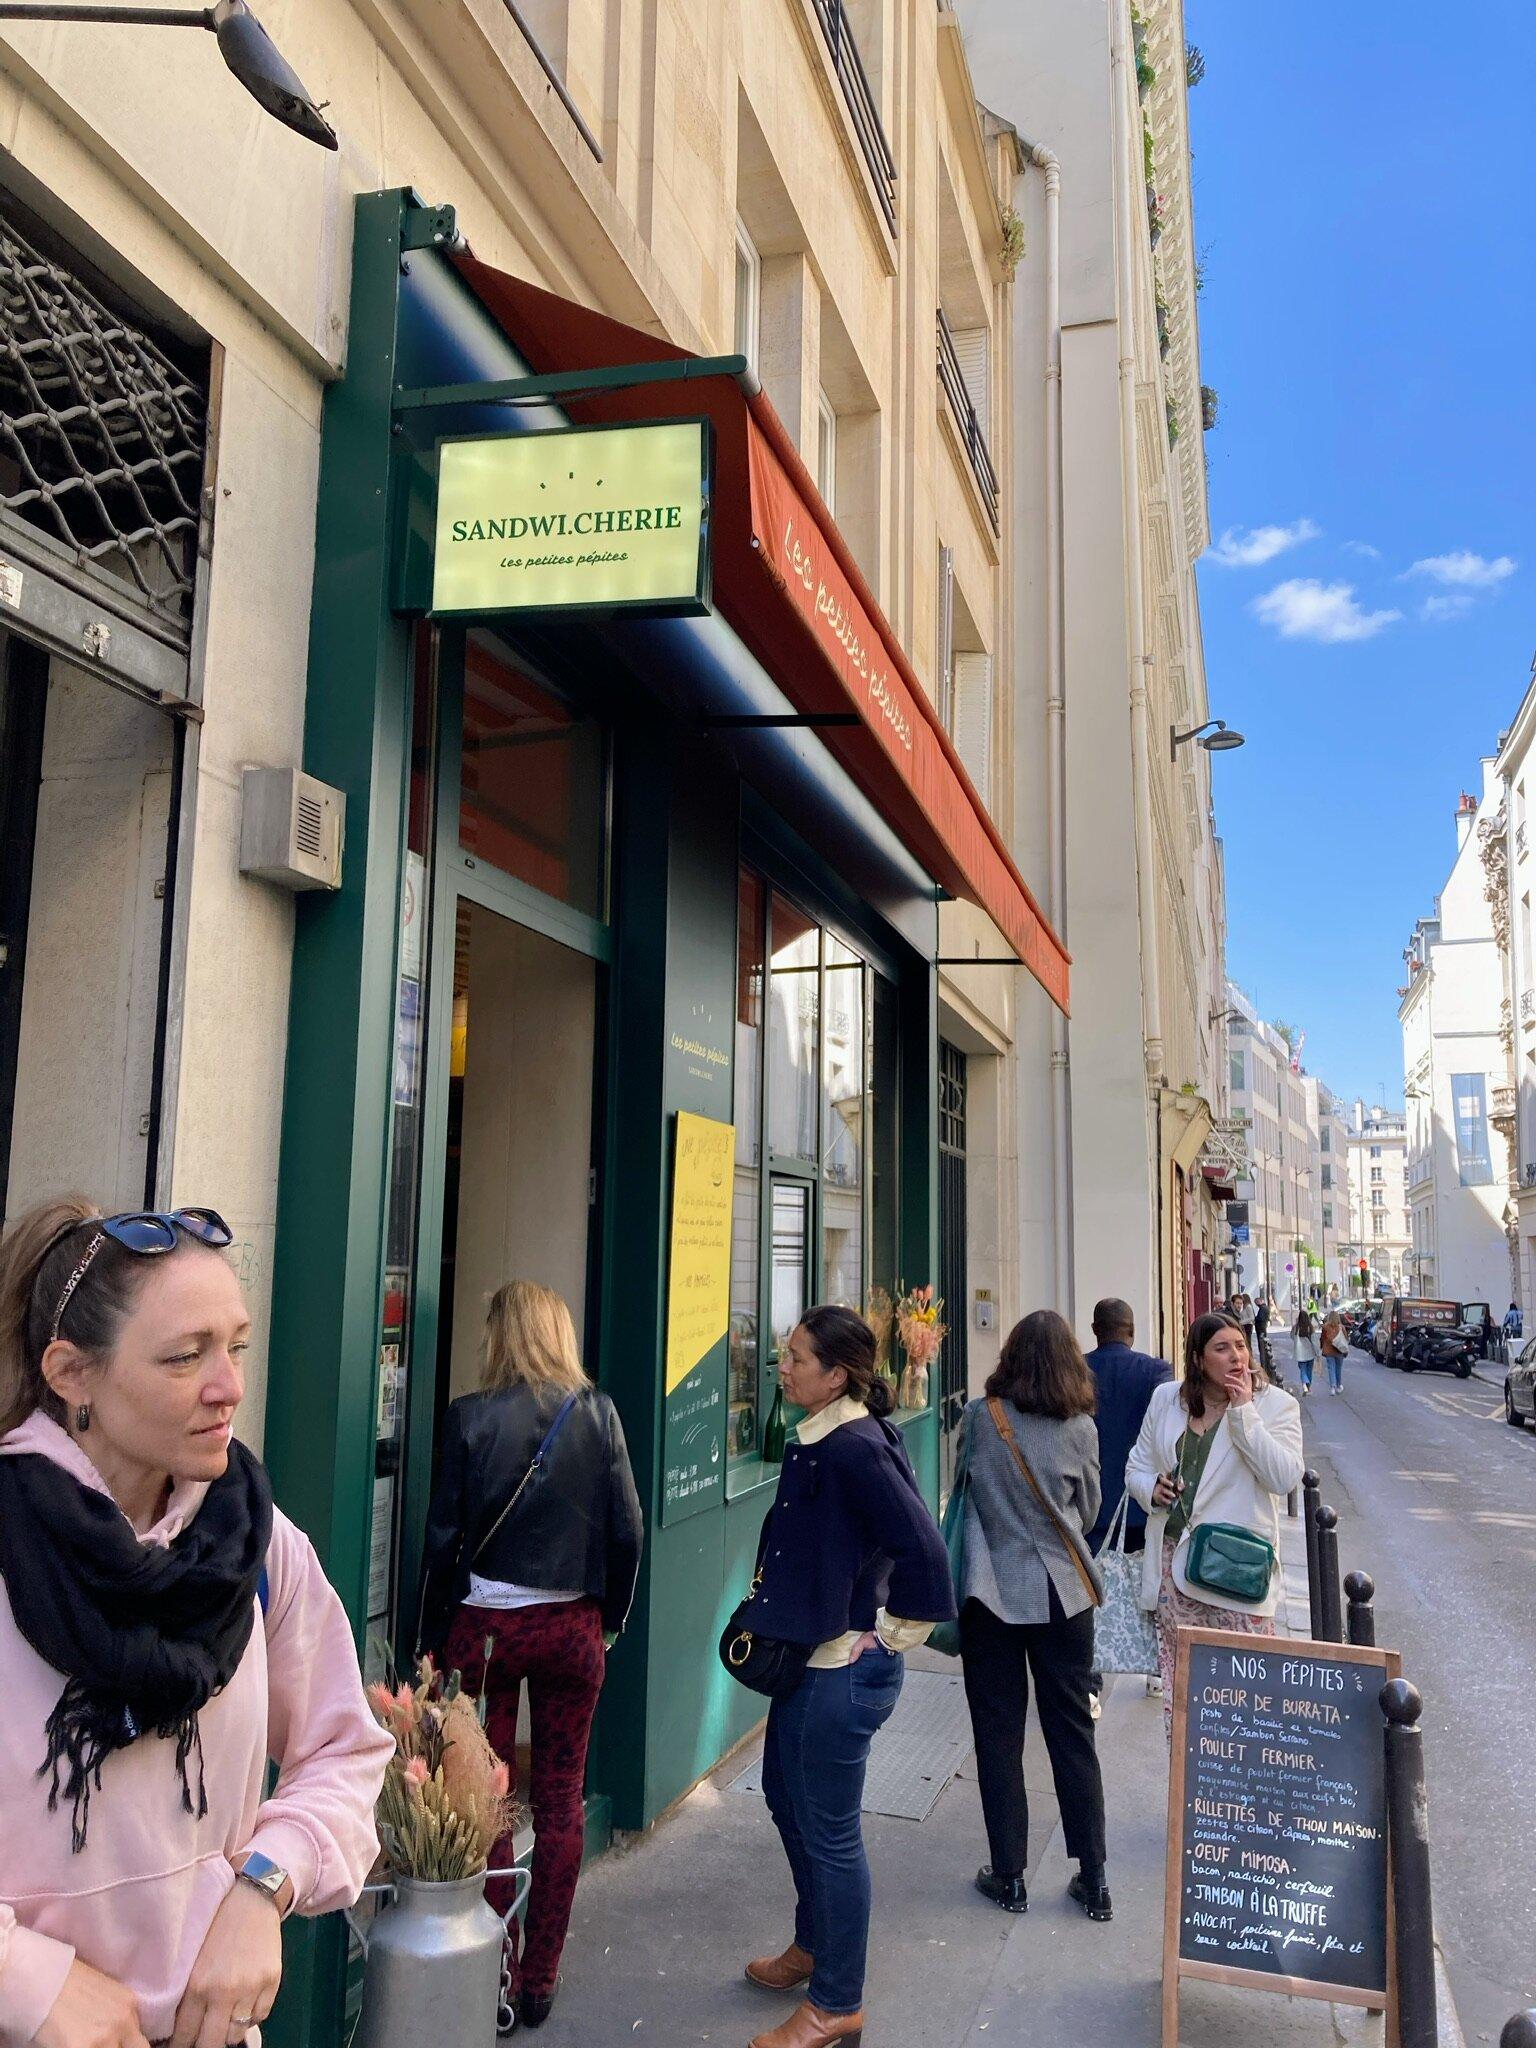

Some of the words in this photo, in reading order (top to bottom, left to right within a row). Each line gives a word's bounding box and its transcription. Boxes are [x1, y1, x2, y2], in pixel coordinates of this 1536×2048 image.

[452, 506, 682, 542] SANDWI.CHERIE
[500, 554, 522, 568] Les
[524, 553, 575, 571] petites
[576, 549, 628, 568] pépites
[785, 517, 813, 590] Les
[815, 578, 867, 678] petites
[671, 1031, 684, 1050] Les
[683, 1040, 707, 1058] petites
[1232, 1655, 1267, 1680] NOS
[1282, 1660, 1344, 1691] PÉPITES
[1202, 1686, 1248, 1708] COEUR
[1254, 1693, 1272, 1712] DE
[1200, 1707, 1223, 1721] pesto
[1231, 1712, 1244, 1723] de
[1253, 1715, 1284, 1728] basilic
[1308, 1725, 1342, 1740] tomates
[1200, 1737, 1247, 1761] POULET
[1198, 1759, 1224, 1772] cuisse
[1230, 1763, 1243, 1774] de
[1247, 1767, 1275, 1780] poulet
[1278, 1769, 1312, 1784] fermier
[1256, 1783, 1286, 1795] maison
[1292, 1789, 1308, 1799] aux
[1194, 1797, 1257, 1823] RILLETTES
[1268, 1811, 1284, 1828] DE
[1293, 1816, 1327, 1833] THON
[1196, 1817, 1229, 1830] zestes
[1233, 1822, 1245, 1833] de
[1194, 1842, 1231, 1863] OEUF
[1194, 1884, 1245, 1908] JAMBON
[1250, 1887, 1259, 1913] À
[1262, 1895, 1279, 1917] LA
[1280, 1899, 1328, 1926] TRUFFE
[1194, 1934, 1220, 1946] sauce
[1349, 1942, 1365, 1954] et
